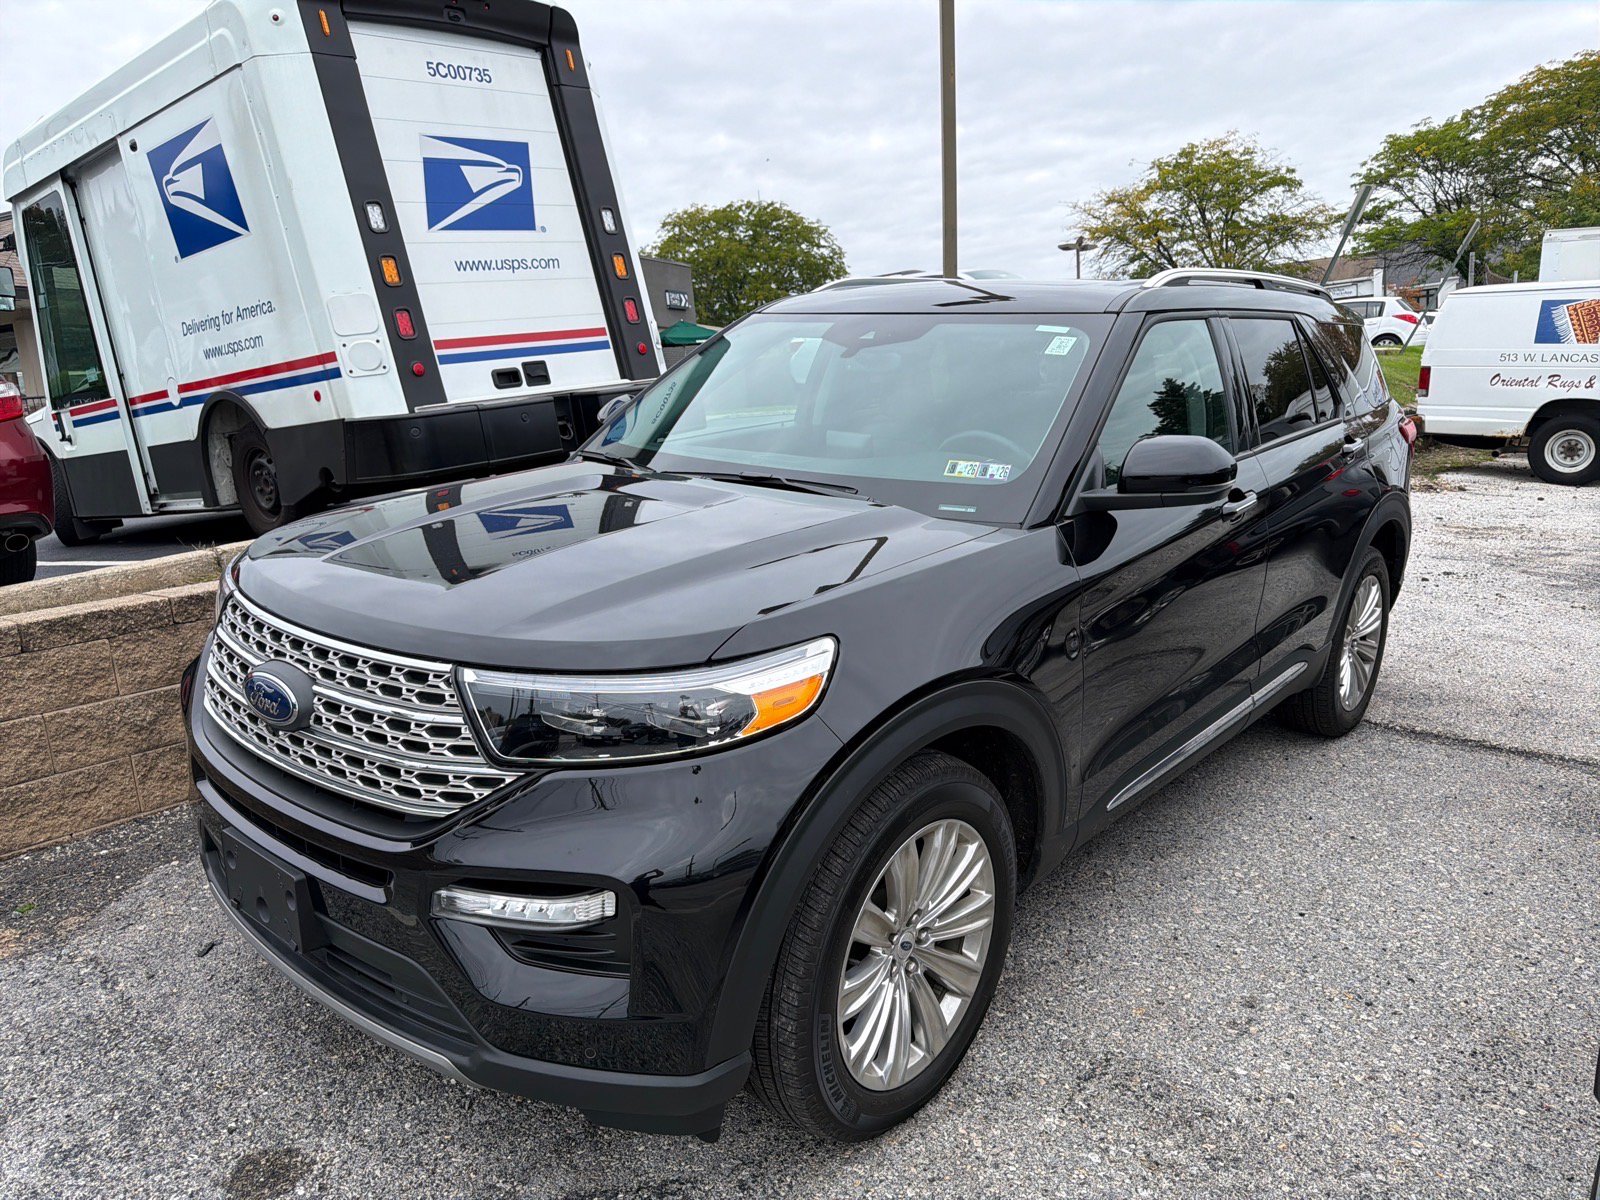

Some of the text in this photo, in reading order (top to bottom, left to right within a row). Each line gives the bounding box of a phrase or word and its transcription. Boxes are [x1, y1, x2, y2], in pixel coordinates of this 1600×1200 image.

[426, 61, 492, 83] 5C00735
[454, 258, 560, 273] www.usps.com
[181, 314, 221, 337] Delivering
[221, 310, 234, 326] for
[203, 335, 264, 360] www.usps.com
[1499, 352, 1599, 363] 513 W. LANCAS
[1489, 373, 1597, 392] Oriental Rugs &
[250, 681, 281, 716] Ford
[820, 1021, 845, 1103] MICHELIN
